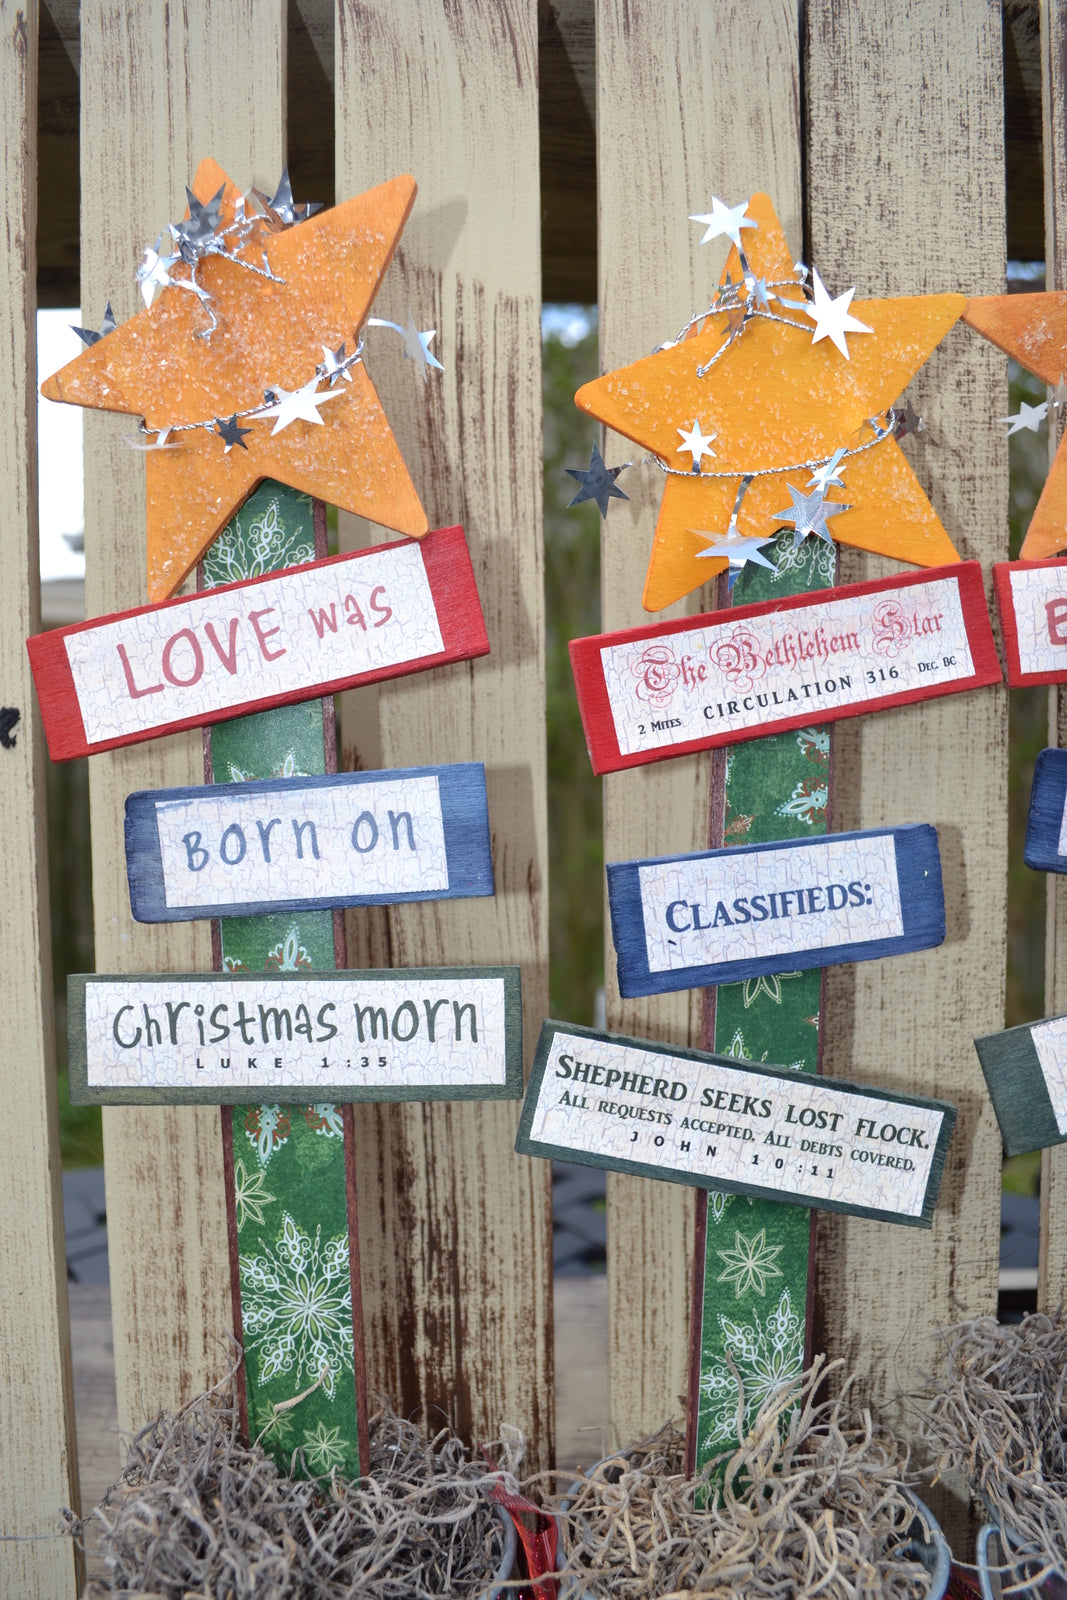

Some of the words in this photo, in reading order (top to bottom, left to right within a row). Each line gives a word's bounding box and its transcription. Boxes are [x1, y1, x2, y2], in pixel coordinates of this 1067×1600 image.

[116, 607, 287, 699] LOVE
[308, 586, 393, 639] was
[631, 645, 708, 708] The
[709, 625, 861, 694] Bethlehem
[871, 599, 944, 658] Star
[638, 724, 646, 735] 2
[703, 676, 852, 719] CIRCULATION
[866, 666, 899, 683] 316
[942, 656, 957, 668] BC
[665, 881, 873, 933] CLASSIFIEDS:
[113, 1000, 338, 1049] Christmas
[353, 998, 479, 1044] morn
[196, 1057, 283, 1070] LUKE
[321, 1056, 388, 1068] 1:35
[555, 1054, 687, 1101] SHEPHERD
[700, 1088, 772, 1118] SEEKS
[784, 1104, 843, 1132] LOST
[854, 1117, 930, 1150] FLOCK.
[598, 1100, 672, 1126] REQUESTS
[680, 1117, 755, 1142] ACCEPTED.
[800, 1139, 843, 1158] DEBTS
[850, 1149, 915, 1171] COVERED.
[630, 1131, 717, 1157] JOHN
[752, 1154, 834, 1179] 10:11
